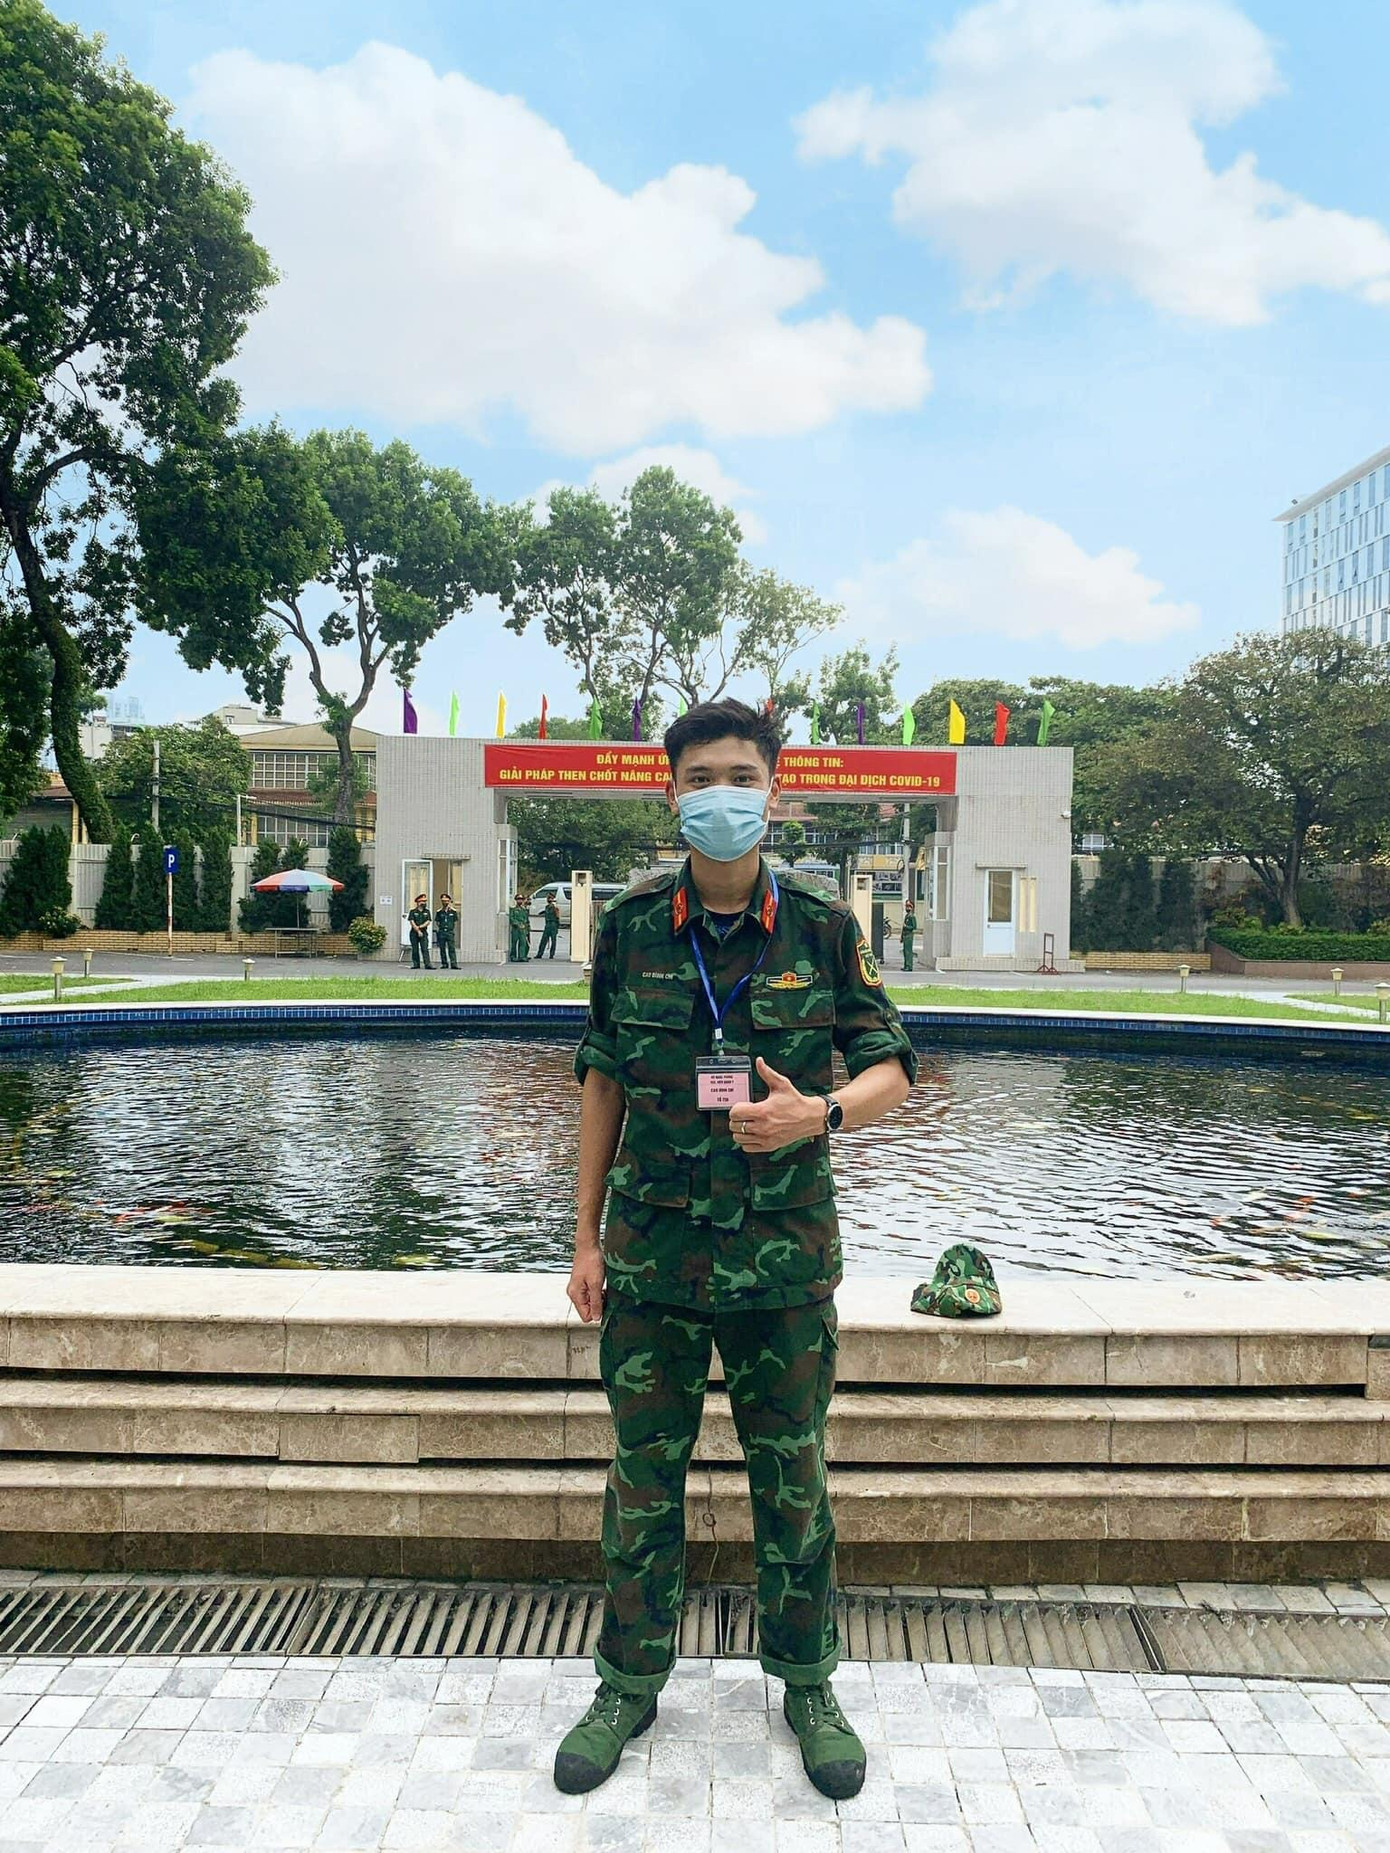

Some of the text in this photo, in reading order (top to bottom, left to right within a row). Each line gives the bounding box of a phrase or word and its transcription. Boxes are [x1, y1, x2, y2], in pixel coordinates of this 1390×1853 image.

[622, 755, 655, 767] MẠNH
[783, 755, 820, 767] THÔNG
[823, 757, 844, 768] TIN:
[500, 766, 522, 780] GIẢI
[525, 768, 555, 781] PHÁP
[558, 770, 587, 781] THEN
[589, 768, 618, 781] CHỐT
[621, 770, 652, 782] NÂNG
[800, 774, 836, 785] TRONG
[839, 775, 857, 787] ĐẠI
[860, 775, 887, 788] DỊCH
[889, 775, 941, 787] COVID-19
[168, 853, 176, 869] P
